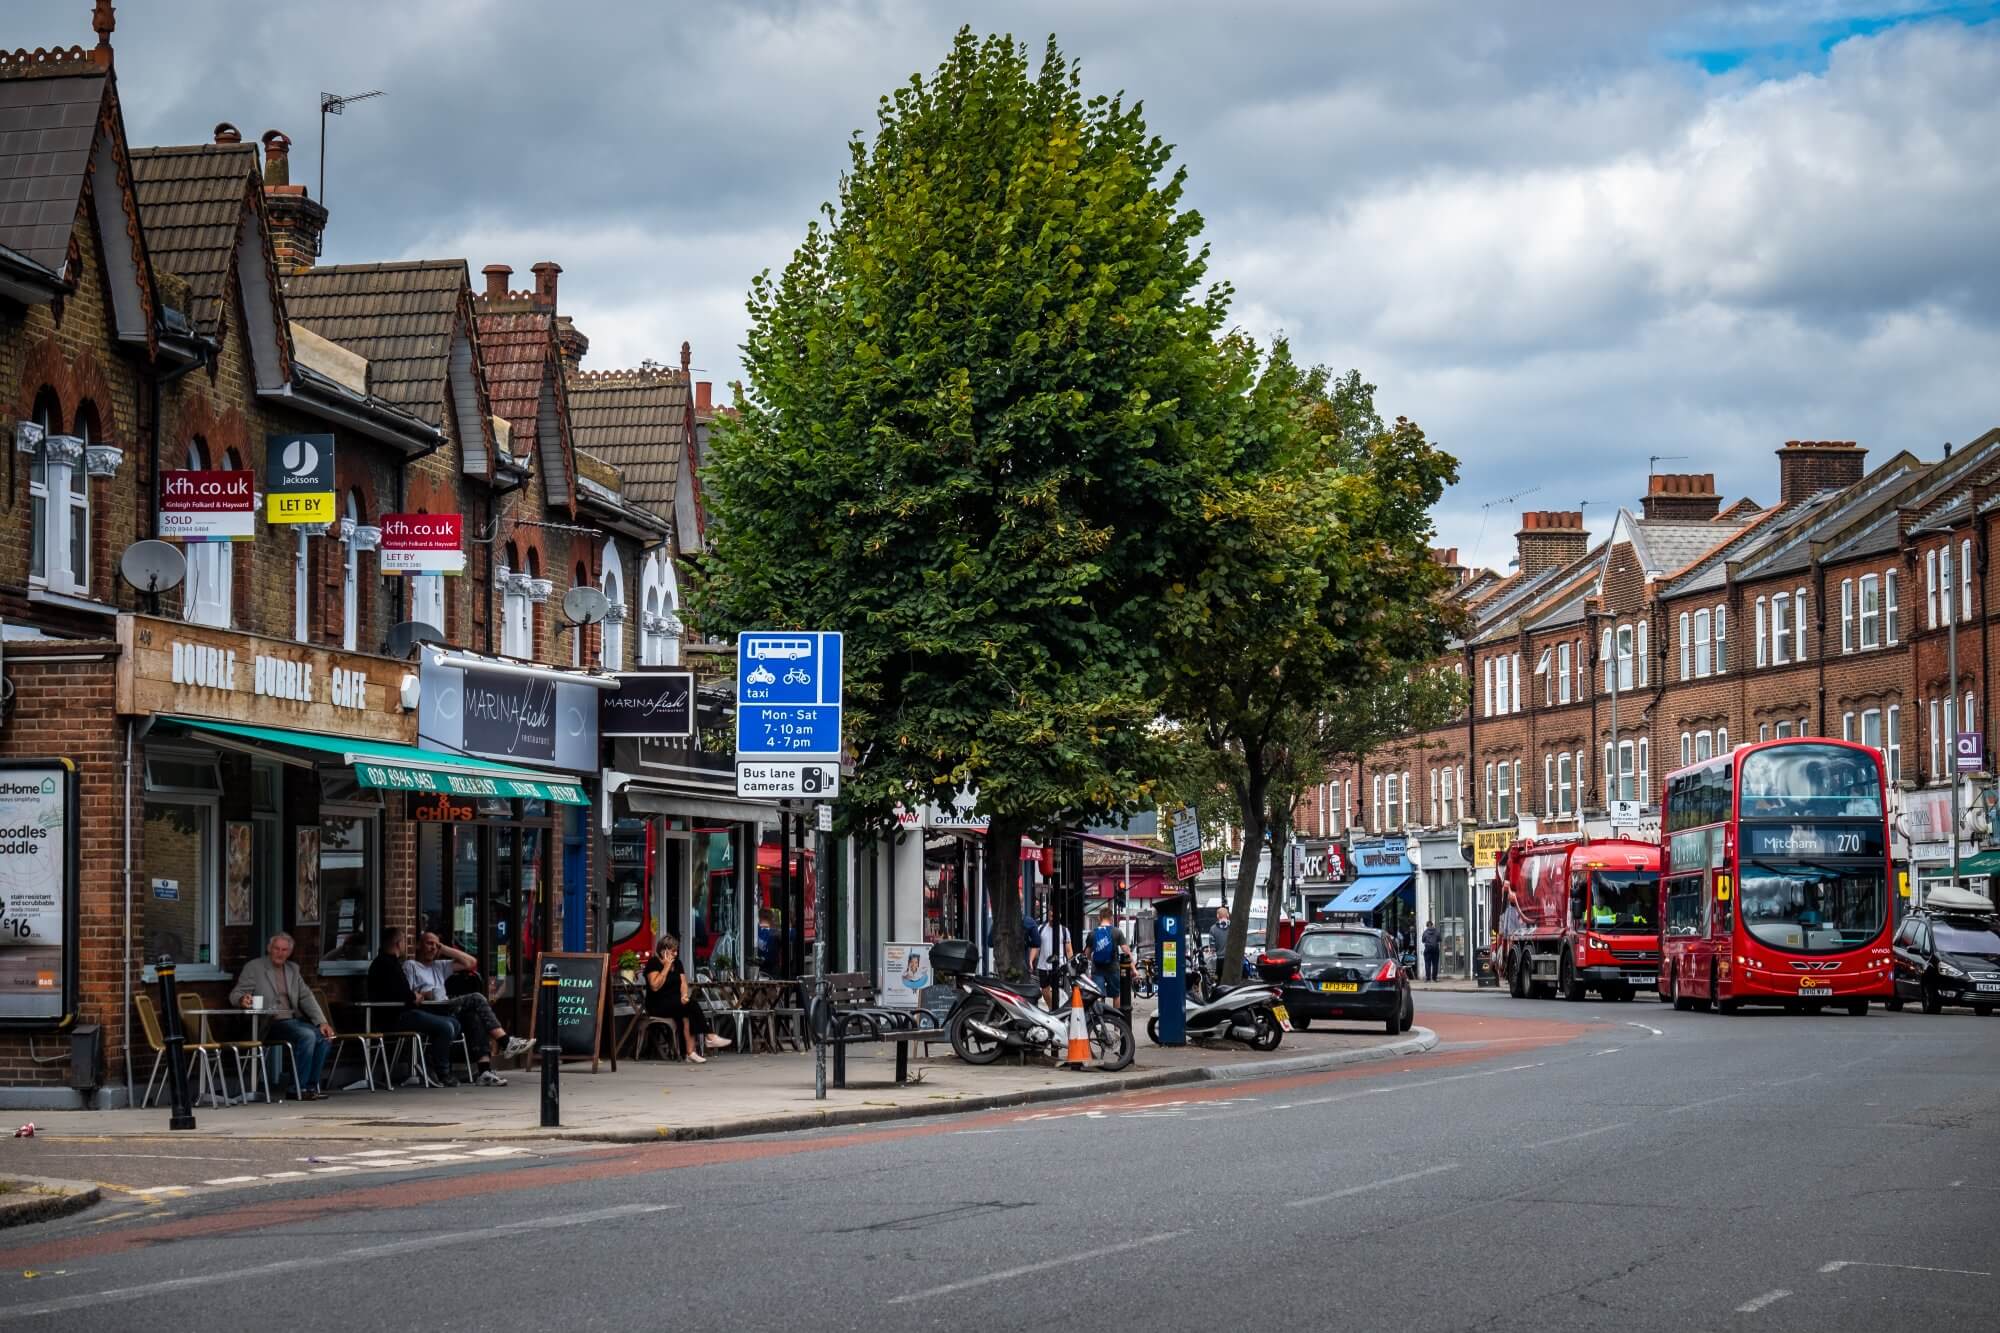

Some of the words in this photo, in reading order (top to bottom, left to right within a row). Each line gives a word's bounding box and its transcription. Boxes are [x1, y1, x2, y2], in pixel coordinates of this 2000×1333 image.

[166, 478, 248, 495] kfh.co.uk
[283, 476, 319, 485] Jacksons
[222, 501, 249, 509] Hayward
[280, 499, 300, 511] LET
[304, 499, 321, 511] BY
[165, 516, 192, 525] SOLD
[386, 521, 454, 535] kfh.co.uk
[386, 553, 401, 561] LET
[403, 553, 415, 561] BY
[172, 641, 235, 691] DOUBLE
[254, 654, 312, 702] BUBBLE
[331, 666, 367, 710] CAFE
[747, 688, 769, 698] taxi
[465, 688, 519, 721] MARINA
[604, 698, 654, 709] MARINA
[642, 690, 688, 717] fish
[762, 709, 788, 720] Mon
[796, 709, 817, 721] Sat
[795, 726, 813, 735] am
[521, 734, 550, 746] restaurant
[793, 738, 811, 749] pm
[367, 767, 388, 786] 020
[743, 768, 766, 779] Bus
[770, 768, 796, 779] lane
[447, 776, 499, 795] BREAKFAST
[547, 785, 581, 803] DINNER
[743, 782, 795, 791] cameras
[415, 806, 473, 821] CHIPS
[935, 816, 992, 825] OPTICIANS
[1764, 837, 1817, 850] Mitcham
[1837, 834, 1860, 853] 270
[1303, 856, 1323, 876] KFC
[3, 918, 31, 938] £16
[1166, 917, 1175, 932] P
[1800, 975, 1816, 988] Go
